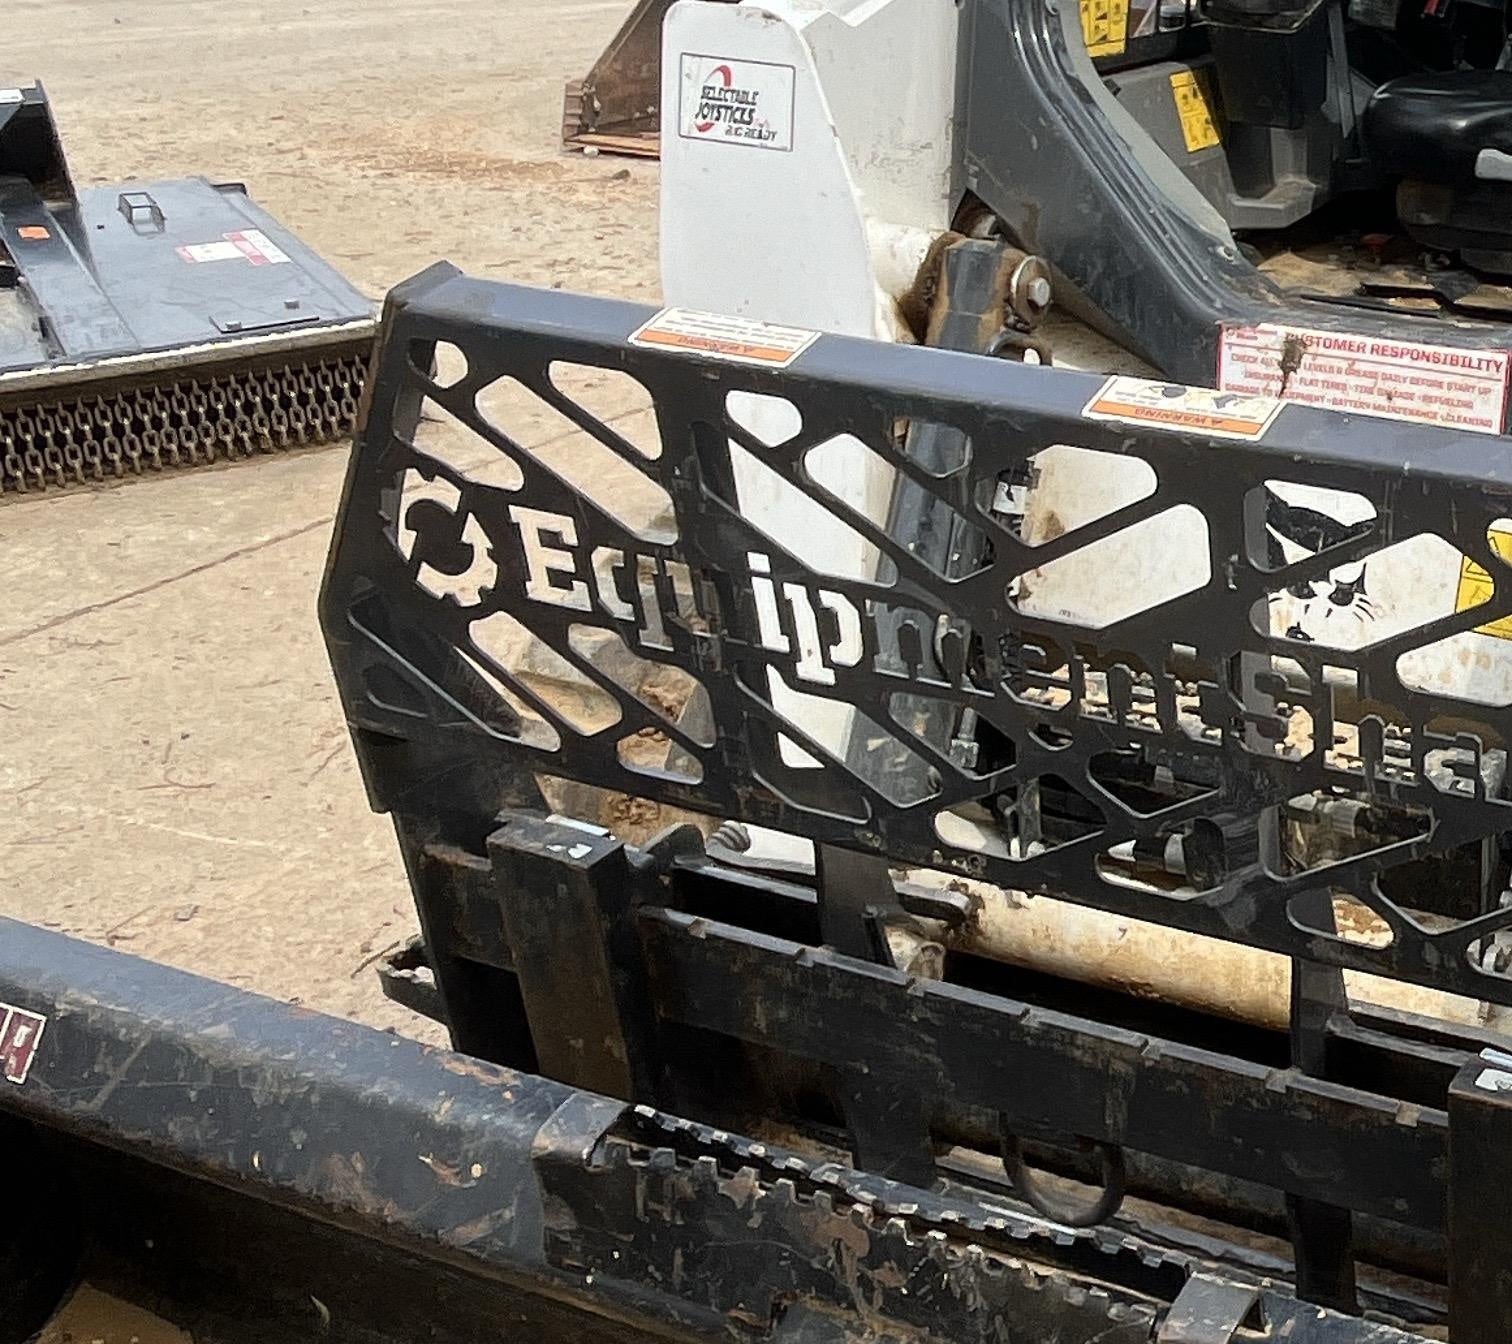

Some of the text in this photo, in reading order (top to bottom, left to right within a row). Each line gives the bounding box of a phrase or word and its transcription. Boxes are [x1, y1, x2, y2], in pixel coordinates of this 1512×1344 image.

[701, 85, 759, 106] SELECTABLE
[695, 102, 756, 126] JOYSTICKS
[1370, 343, 1503, 373] RESPONSIBILITY
[1477, 386, 1492, 395] UP
